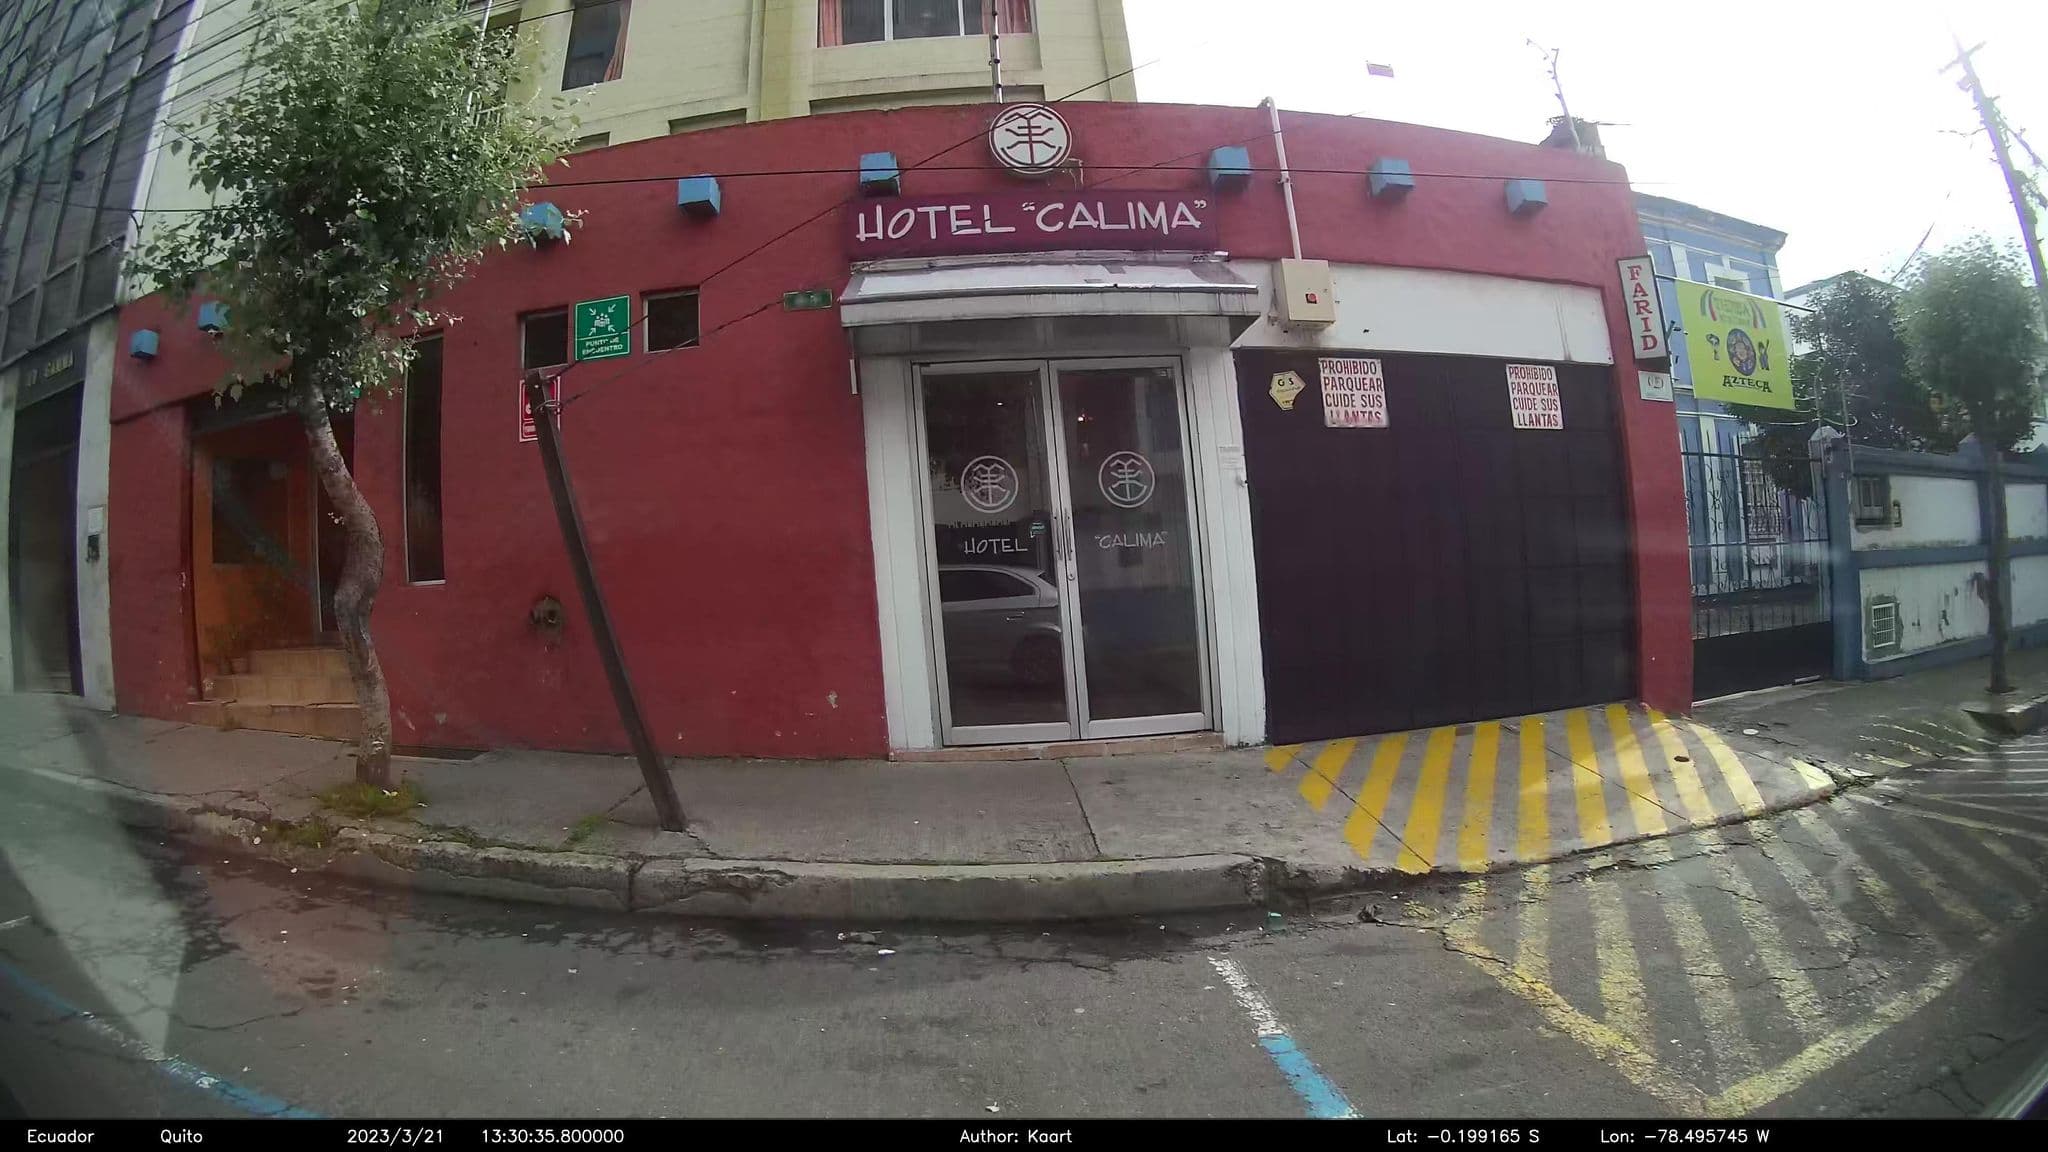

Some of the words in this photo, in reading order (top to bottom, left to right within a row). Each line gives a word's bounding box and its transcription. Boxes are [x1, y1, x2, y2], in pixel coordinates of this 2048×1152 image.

[856, 204, 1016, 241] HOTEL
[1627, 264, 1658, 351] FARID
[1321, 360, 1377, 375] PROHIBIDO
[1509, 366, 1552, 380] PROHIBIDO
[1323, 376, 1384, 392] PARQUEAR
[1511, 382, 1559, 396] PARQUEAR
[1722, 375, 1773, 393] AZTECA
[1325, 393, 1356, 408] CUIDE
[1361, 394, 1383, 408] SUS
[1513, 397, 1537, 410] CUIDE
[1541, 398, 1559, 411] SUS
[1517, 413, 1559, 427] LLANTAS
[963, 536, 1028, 555] HOTEL
